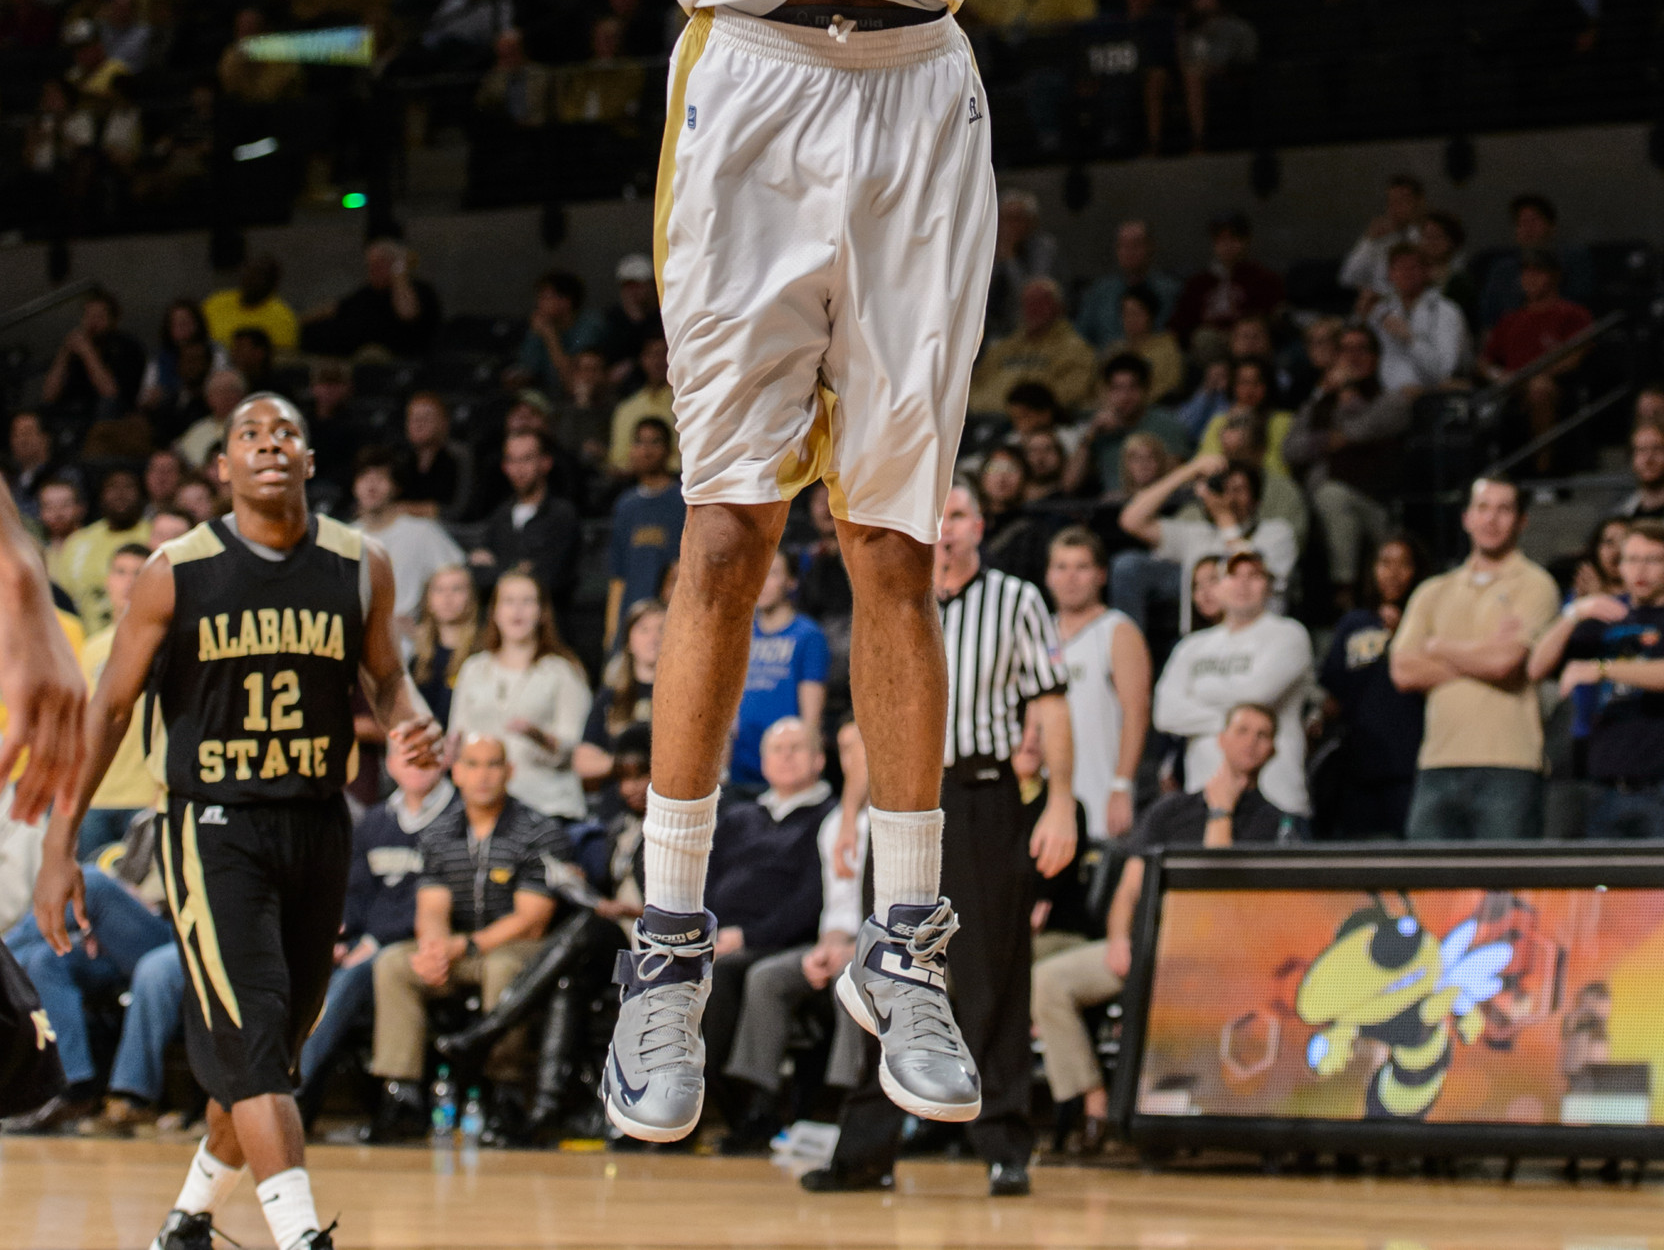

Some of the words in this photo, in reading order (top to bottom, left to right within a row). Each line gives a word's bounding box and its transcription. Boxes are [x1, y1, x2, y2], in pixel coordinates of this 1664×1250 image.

[198, 607, 345, 662] ALABAMA
[243, 669, 303, 732] 12
[198, 736, 330, 783] STATE
